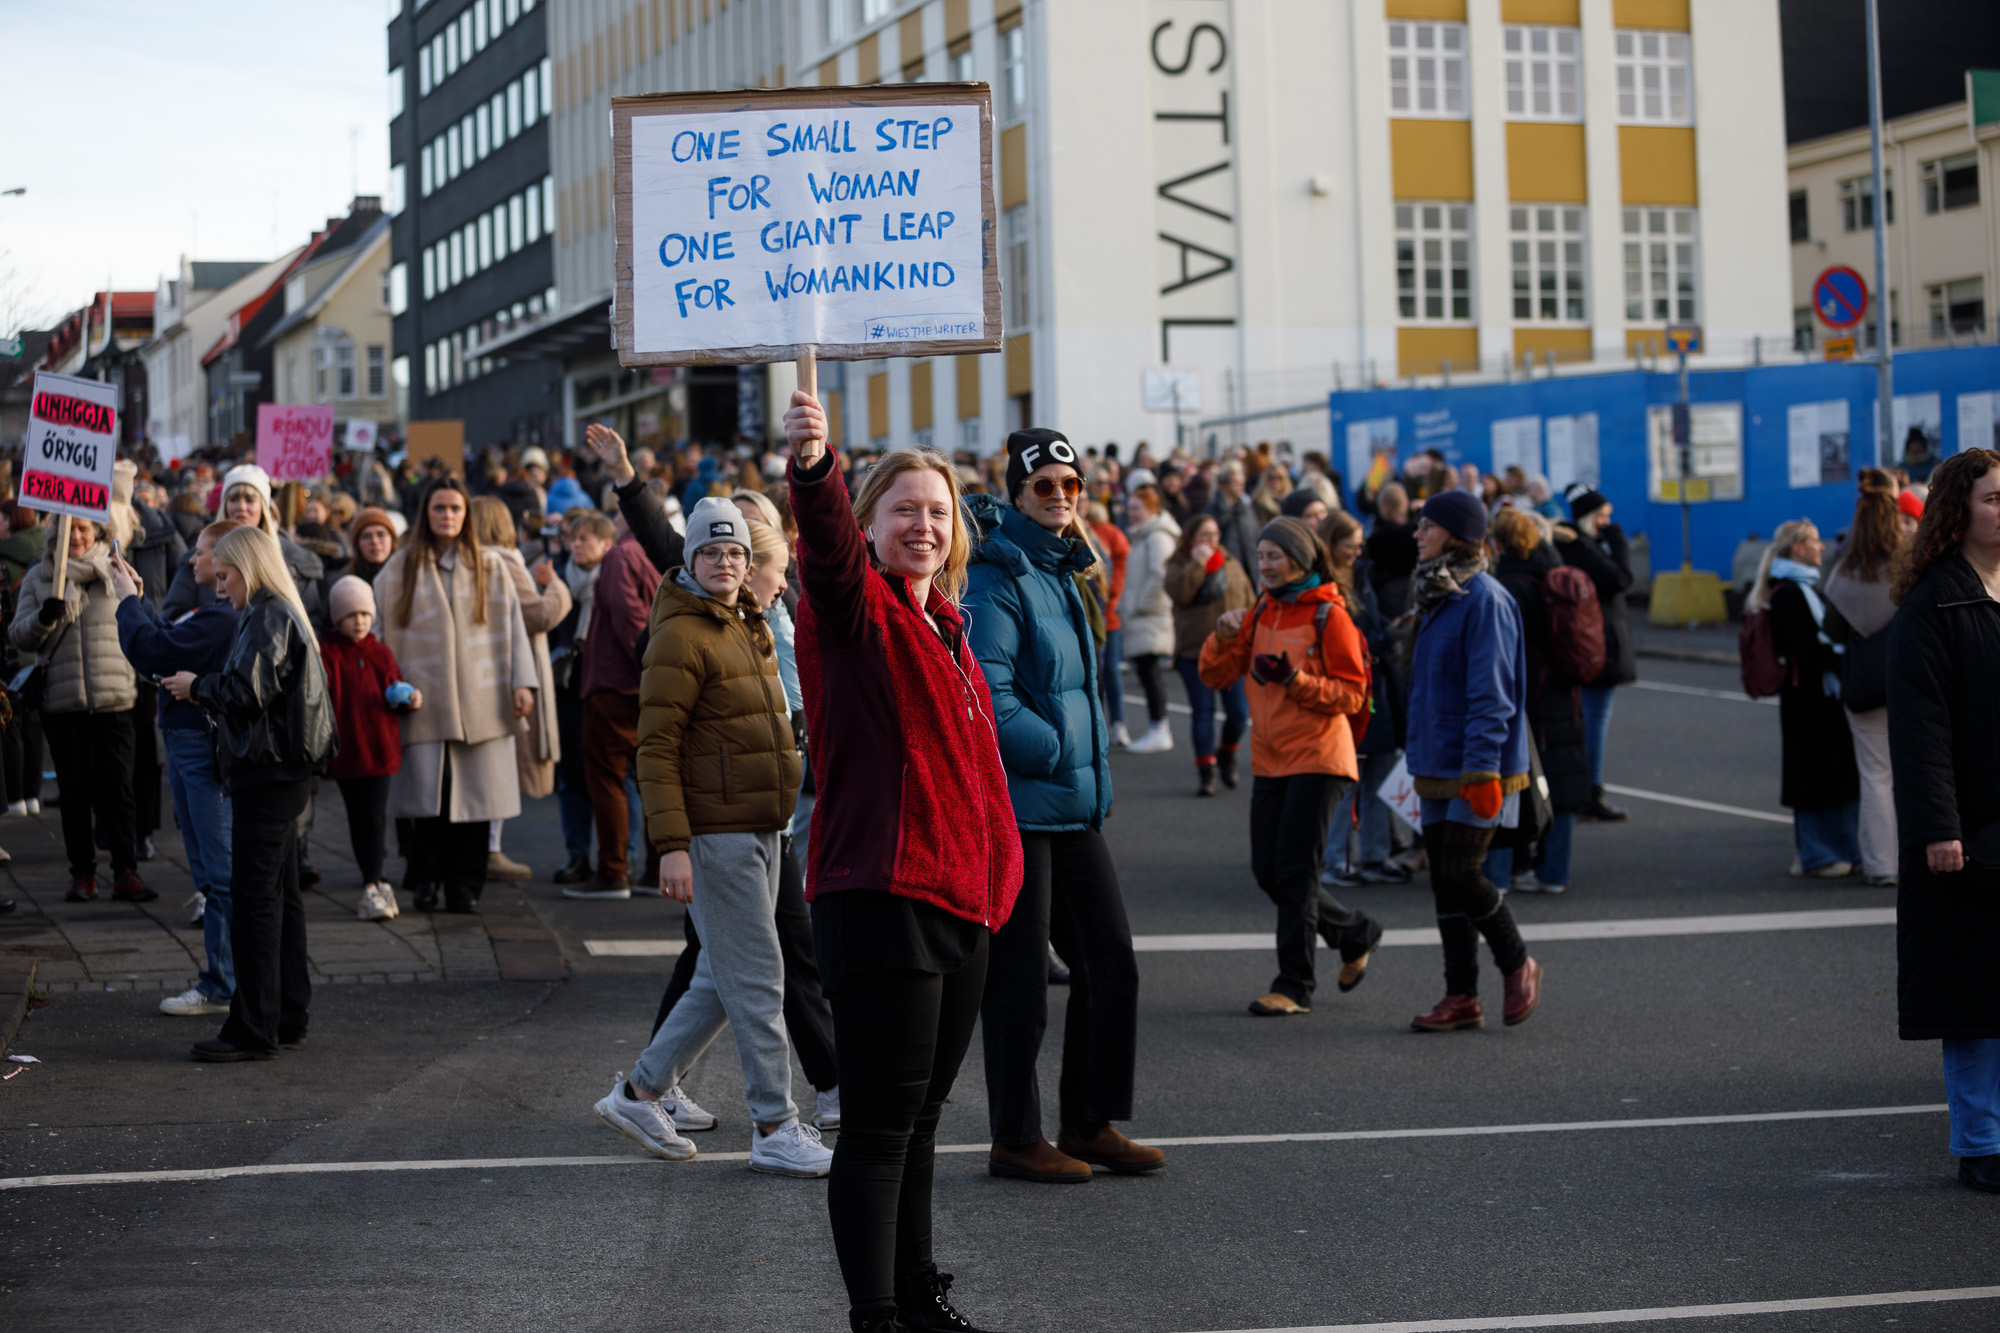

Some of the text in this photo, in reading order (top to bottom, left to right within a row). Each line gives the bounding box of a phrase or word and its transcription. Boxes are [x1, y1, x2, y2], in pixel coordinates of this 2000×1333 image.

[672, 117, 954, 163] ONE SMALL STEP
[708, 169, 920, 220] FOR WOMAN
[1151, 0, 1235, 363] STVAL
[659, 211, 956, 268] ONE GIANT LEAP
[675, 261, 956, 318] FOR WOMANKIND
[42, 430, 97, 471] ÖRYGGI
[1021, 440, 1075, 474] FO
[70, 484, 107, 511] ALLA
